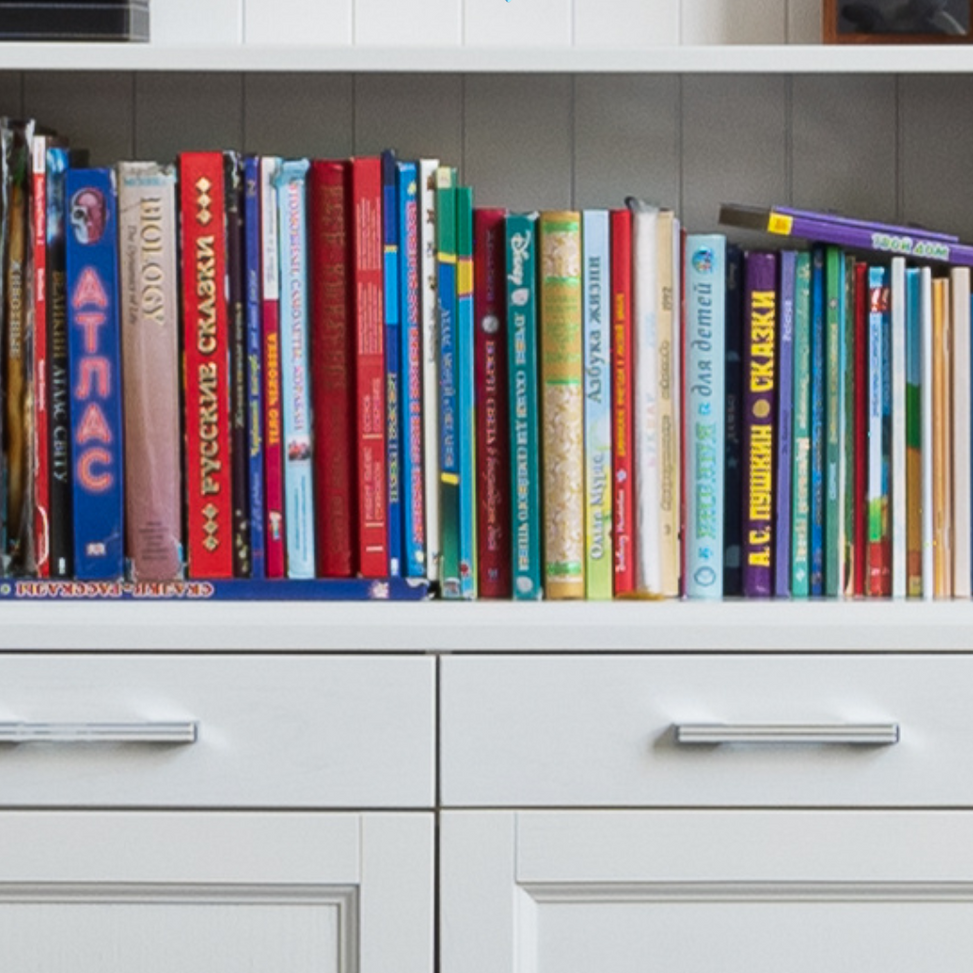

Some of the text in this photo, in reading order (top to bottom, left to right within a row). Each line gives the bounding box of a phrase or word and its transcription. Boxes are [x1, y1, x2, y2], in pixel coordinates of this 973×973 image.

[141, 198, 165, 325] BIOLOGY
[507, 229, 532, 286] Disney
[912, 239, 950, 260] ДОМ
[586, 256, 603, 404] Азбука жизни
[689, 286, 713, 356] детей
[196, 235, 221, 496] РУССКИЕ СКАЗКИ
[691, 362, 713, 401] для
[267, 409, 281, 446] ТЕЛО
[748, 291, 775, 567] А. С. ПУШКИН СКАЗКИ
